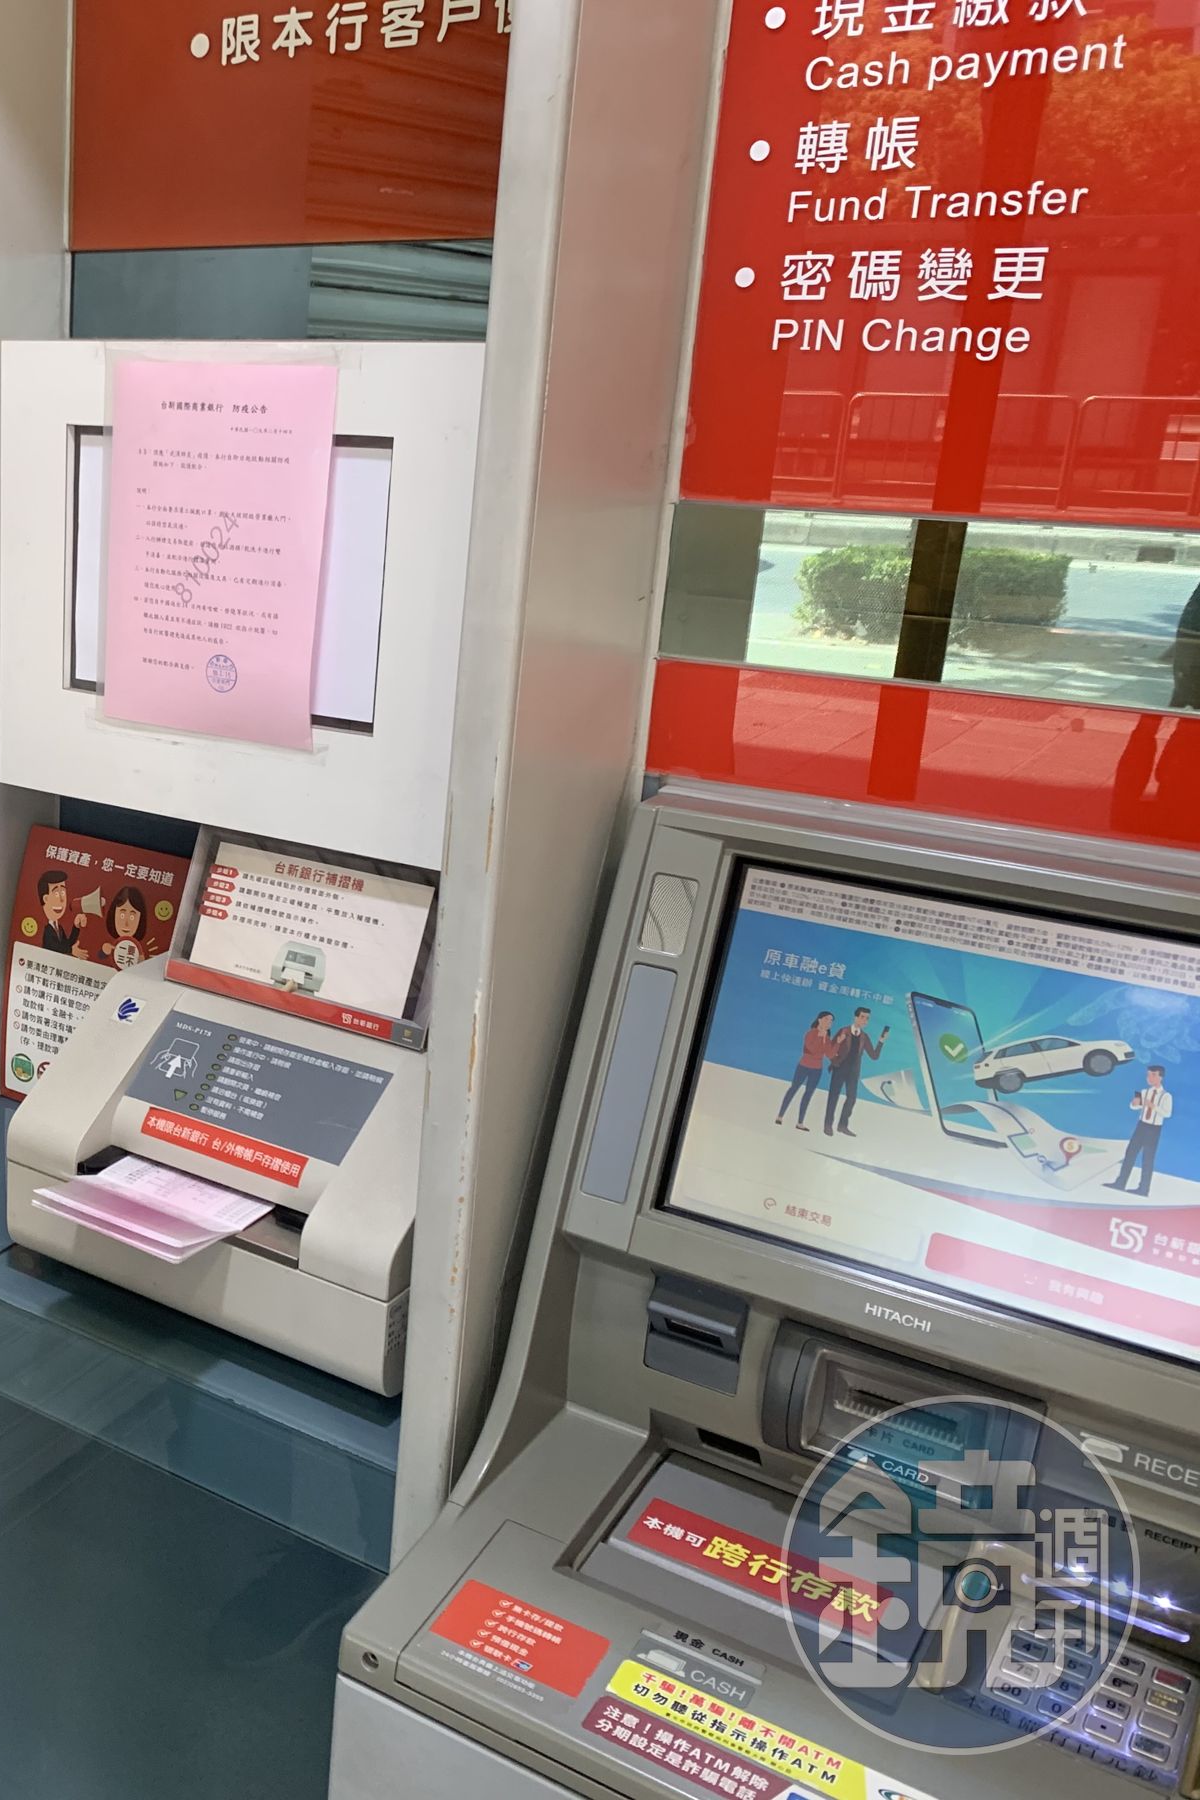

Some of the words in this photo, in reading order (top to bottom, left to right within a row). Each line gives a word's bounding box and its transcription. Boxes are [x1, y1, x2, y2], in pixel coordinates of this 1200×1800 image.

[805, 52, 911, 91] Cash
[927, 34, 1128, 91] payment
[794, 115, 921, 175] 轉帳
[786, 187, 888, 224] Fund
[904, 180, 1089, 220] Transfer
[780, 246, 1050, 302] 密碼變更
[771, 318, 846, 352] PIN
[861, 318, 1032, 361] Change
[232, 403, 269, 415] 防疫公告
[45, 844, 175, 888] 保護資產，您一定要知道
[273, 861, 366, 893] 台新銀行補摺機
[763, 948, 847, 980] 原車融e貸
[20, 1022, 69, 1045] 請勿委由理專
[146, 1116, 209, 1147] 本機限台新銀行
[211, 1138, 302, 1178] 台/外幣帳戶存摺使用
[784, 1203, 833, 1227] 結束交易
[864, 1301, 932, 1334] HITACHI
[902, 1438, 935, 1457] CARD
[881, 1460, 929, 1483] CARD
[1143, 1528, 1200, 1554] RECEIPT
[497, 1624, 537, 1647] 跨行存款
[673, 1630, 705, 1650] 現金
[711, 1648, 745, 1667] CASH
[690, 1670, 747, 1702] CASH
